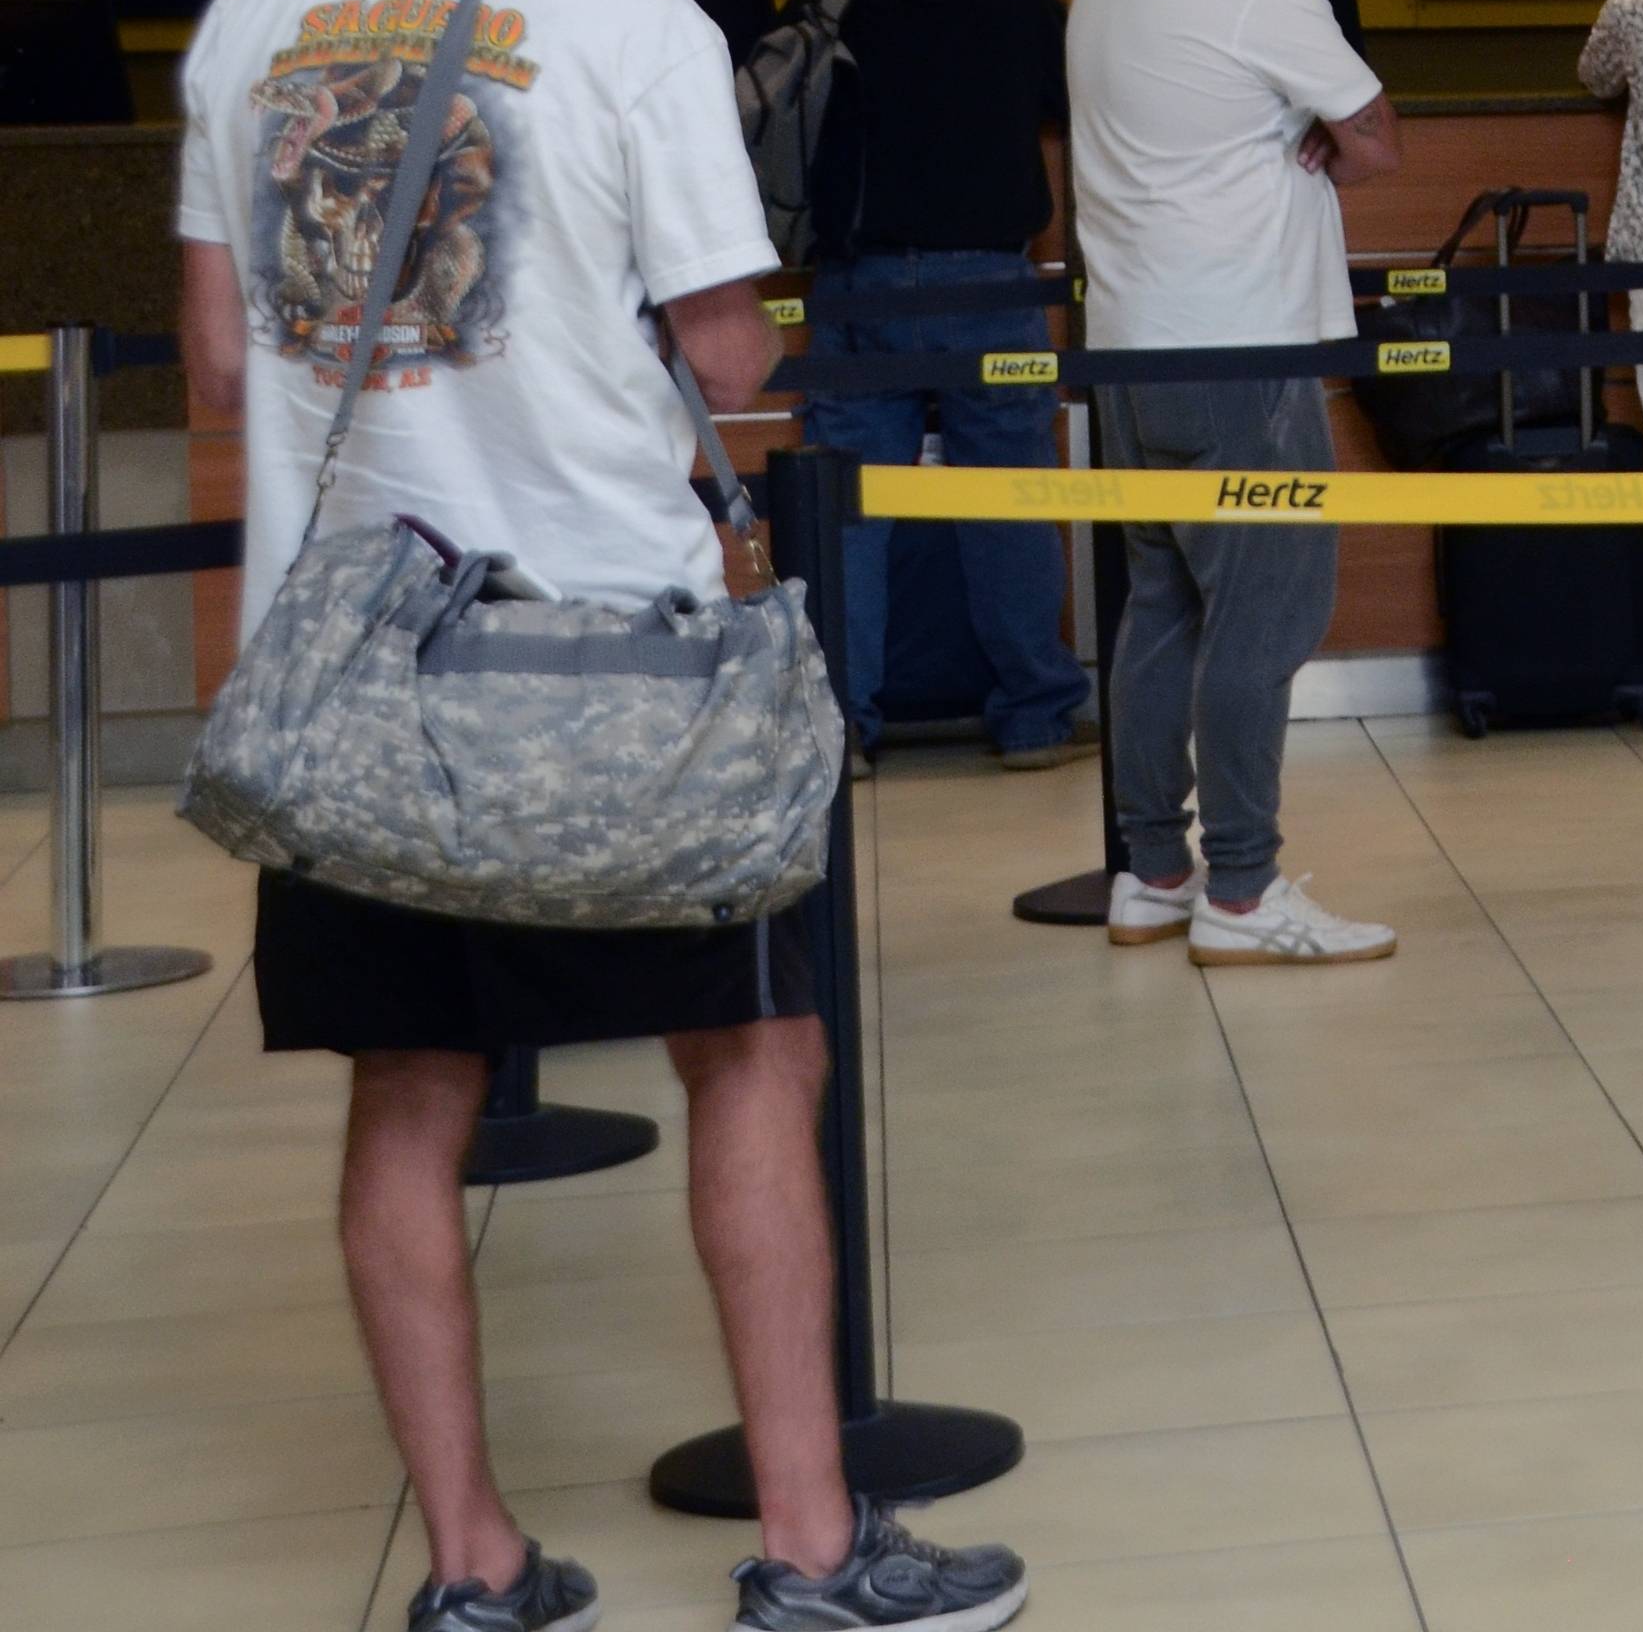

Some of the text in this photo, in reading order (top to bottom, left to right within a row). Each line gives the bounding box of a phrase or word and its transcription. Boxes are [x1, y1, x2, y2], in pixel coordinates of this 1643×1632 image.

[1391, 271, 1441, 290] Hertz
[1384, 347, 1445, 367] Hertz
[989, 357, 1051, 379] Hertz
[1216, 476, 1327, 509] Hertz
